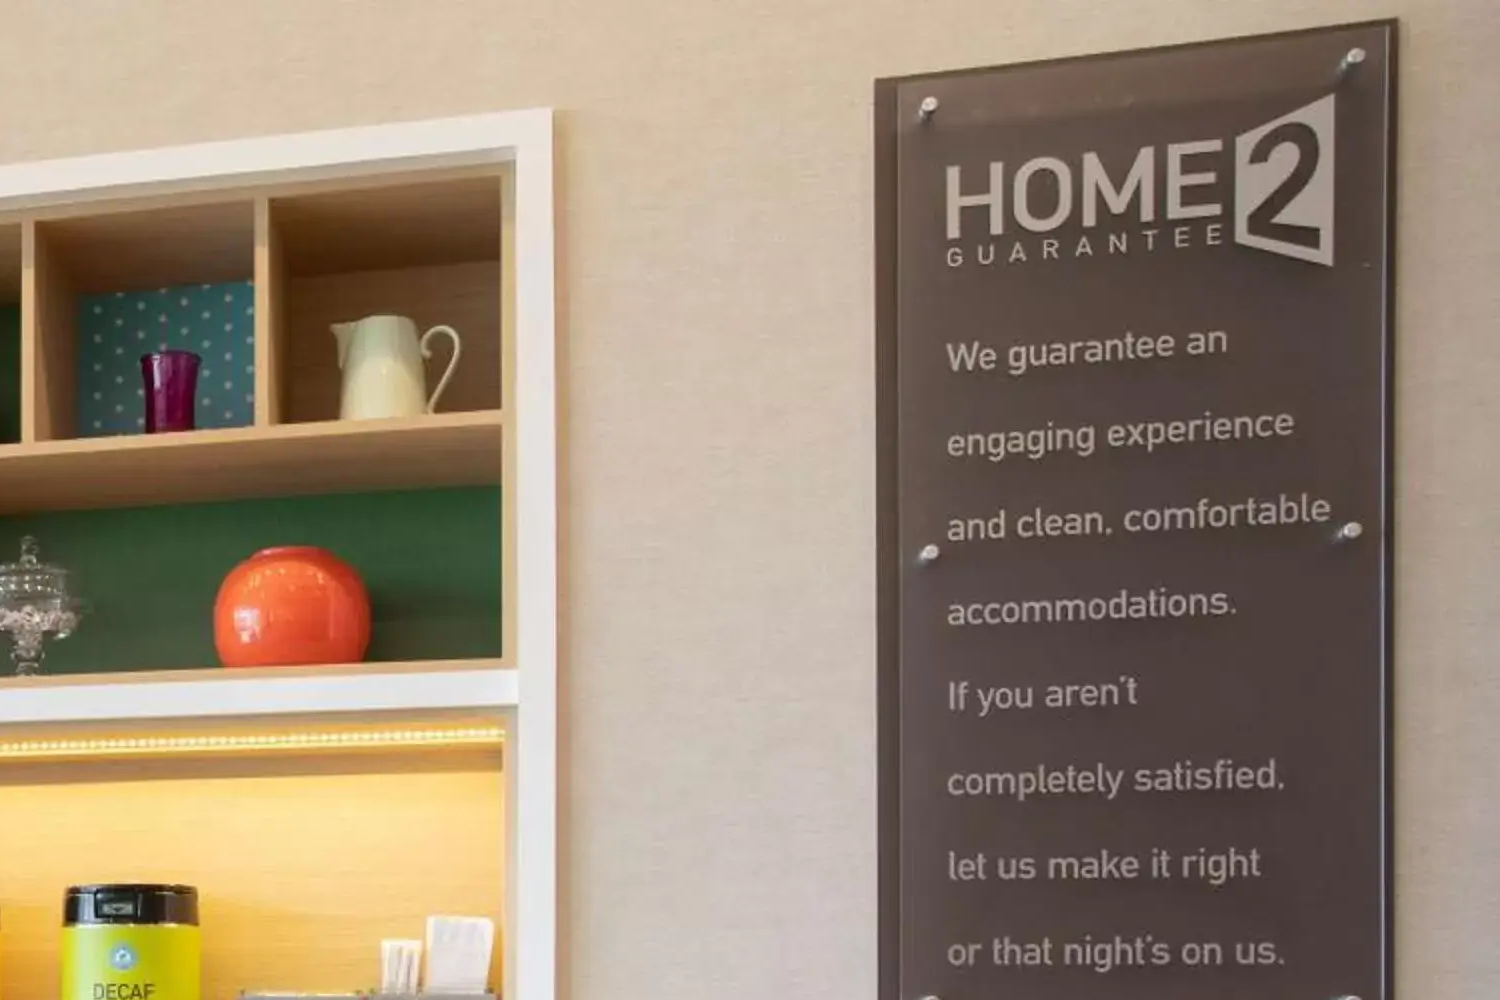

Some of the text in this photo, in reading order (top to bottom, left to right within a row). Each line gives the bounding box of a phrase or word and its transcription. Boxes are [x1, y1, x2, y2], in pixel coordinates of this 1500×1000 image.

[946, 118, 1324, 253] HOME 2
[946, 224, 1223, 267] GUARANTEE
[946, 330, 1228, 376] We guarantee an
[947, 411, 1295, 462] engaging experience
[947, 509, 1006, 541] and
[1123, 492, 1332, 533] comfortable
[947, 587, 1237, 625] accommodations.
[949, 675, 1138, 717] If you aren't
[947, 762, 1124, 801] completely
[948, 846, 1262, 885] let us make it right
[947, 934, 1285, 972] or that night's on us.
[92, 982, 156, 1000] DECAF
